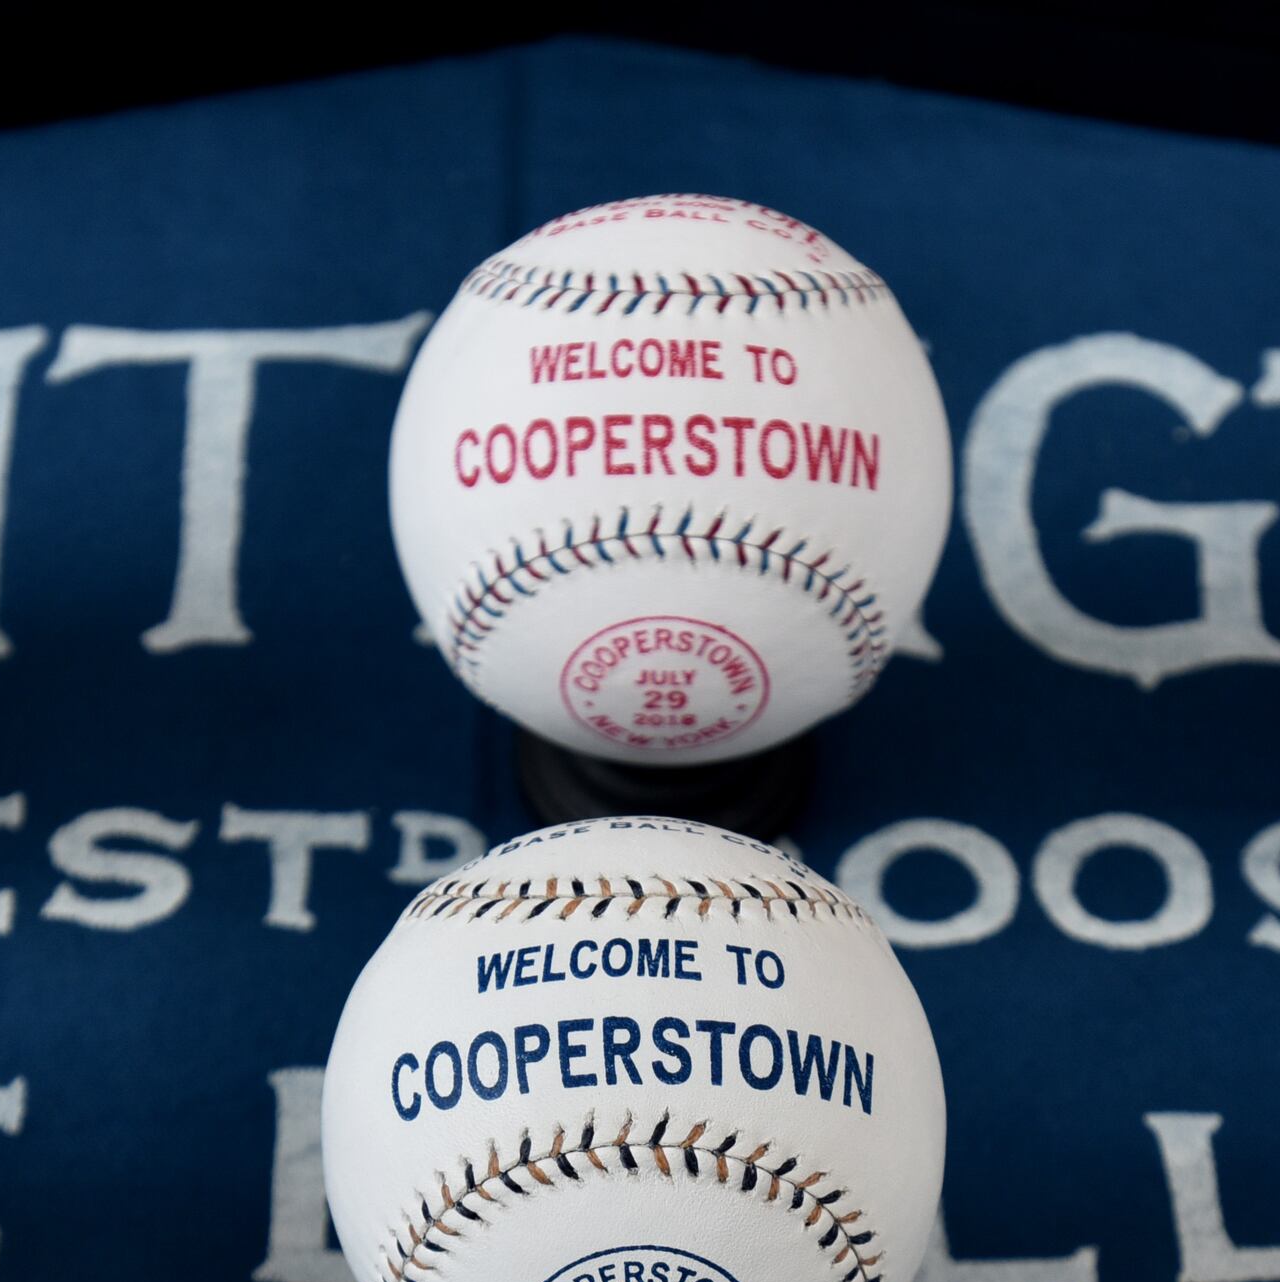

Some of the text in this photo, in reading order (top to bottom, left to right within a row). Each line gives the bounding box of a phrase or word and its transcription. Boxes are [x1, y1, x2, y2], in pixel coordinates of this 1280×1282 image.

[644, 208, 729, 223] BALL
[530, 338, 797, 386] WELCOME TO
[455, 413, 879, 490] COOPERSTOWN
[574, 627, 756, 696] COOPERSTOWN
[635, 669, 697, 686] JULY
[633, 713, 698, 726] 2018
[643, 690, 688, 710] 29
[500, 825, 591, 855] BASE
[610, 821, 705, 836] BALL
[476, 938, 786, 994] WELCOME TO
[391, 1015, 874, 1122] COOPERSTOWN
